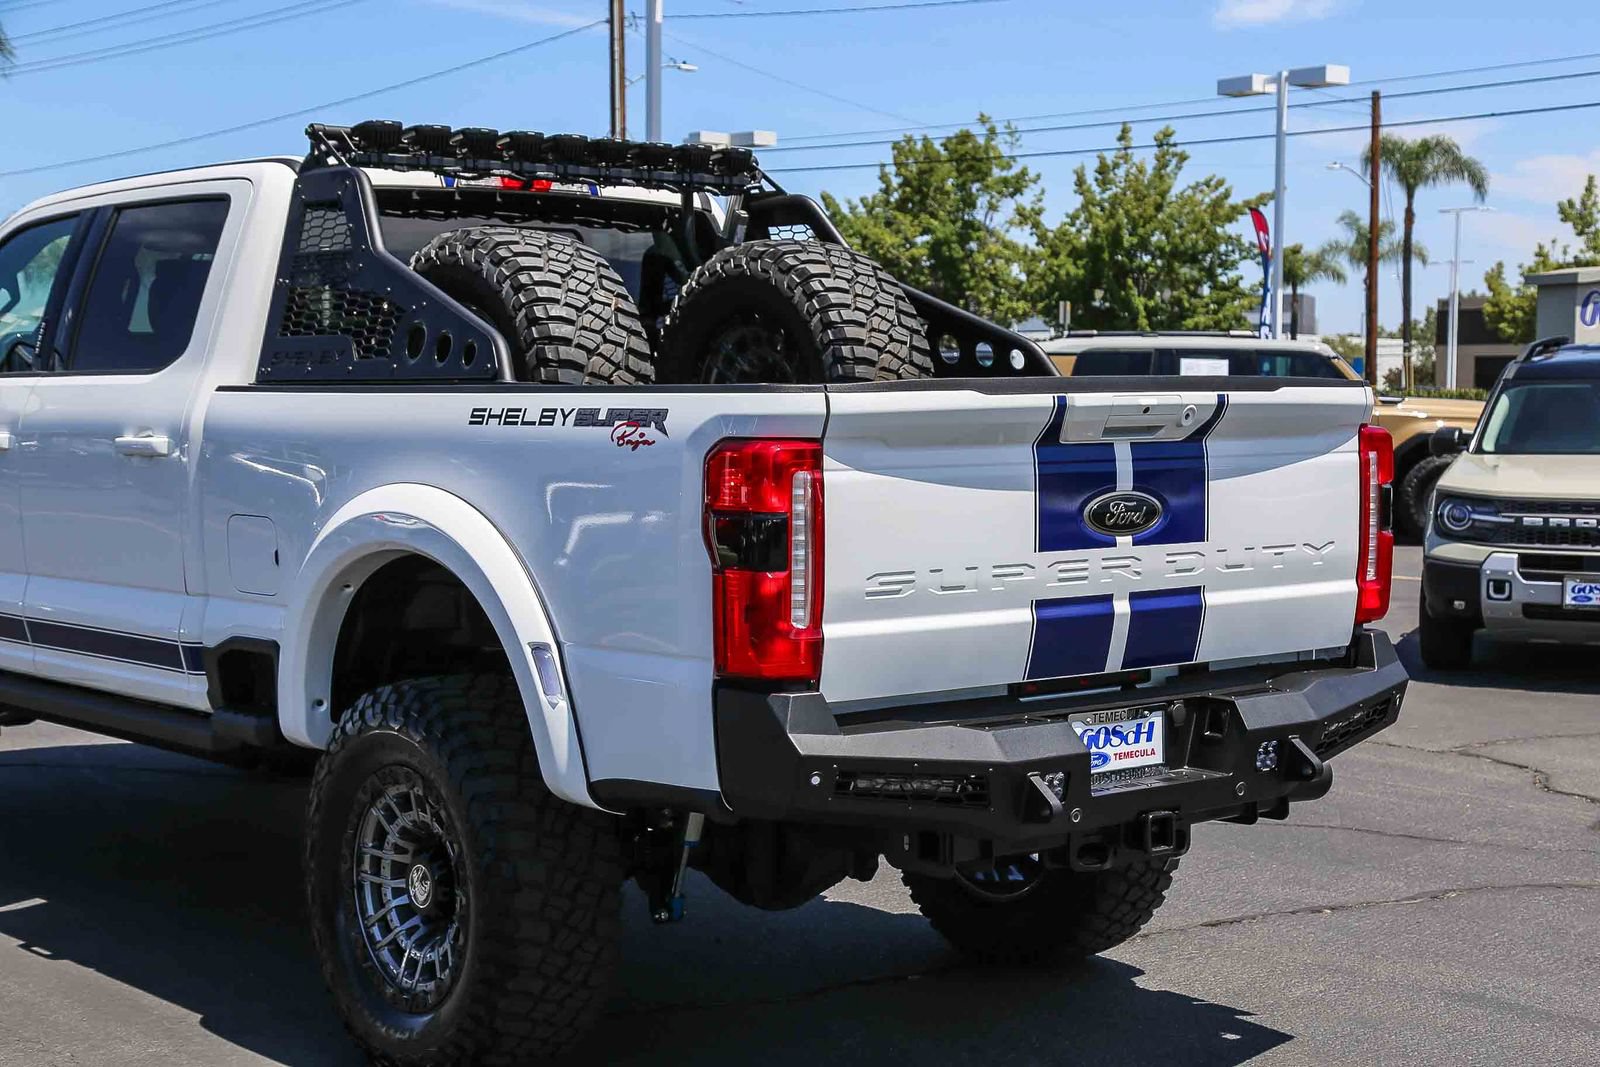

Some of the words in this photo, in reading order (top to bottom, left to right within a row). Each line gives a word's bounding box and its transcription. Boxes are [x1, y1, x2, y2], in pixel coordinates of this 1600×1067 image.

[468, 408, 576, 426] SHELBY
[611, 421, 656, 452] Baja
[1105, 500, 1147, 526] Ford
[865, 555, 1142, 600] SUPER
[1166, 541, 1335, 578] DUTY
[1113, 747, 1156, 761] TEMECULA
